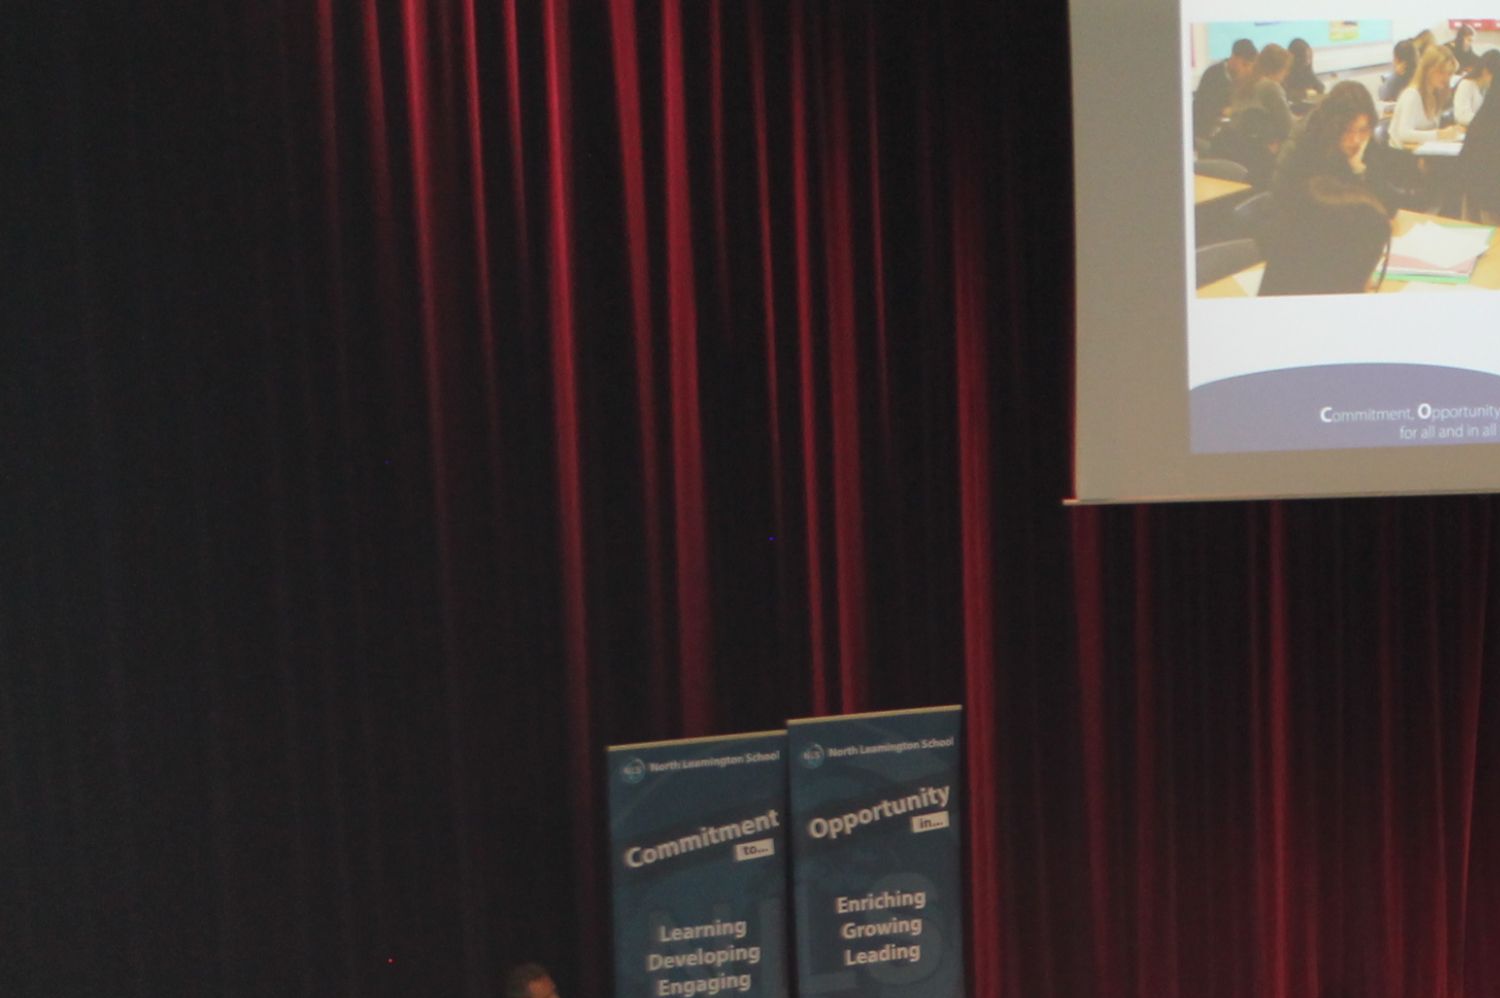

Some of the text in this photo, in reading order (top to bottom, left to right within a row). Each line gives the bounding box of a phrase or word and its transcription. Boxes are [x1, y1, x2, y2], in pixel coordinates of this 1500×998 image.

[1320, 406, 1415, 423] Commitment,
[1400, 426, 1417, 439] for
[1421, 425, 1435, 439] all
[1439, 424, 1463, 438] and
[1467, 424, 1479, 437] in
[1482, 423, 1496, 436] all
[829, 736, 954, 757] North Leamington School
[650, 751, 780, 772] North Leamington School
[809, 786, 950, 838] Opportunity
[625, 809, 780, 868] Commitment
[836, 890, 926, 914] Enriching
[660, 920, 747, 942] Learning
[842, 917, 922, 940] Growing
[647, 945, 761, 971] Developing
[844, 944, 921, 966] Leading
[657, 973, 752, 997] Engaging
